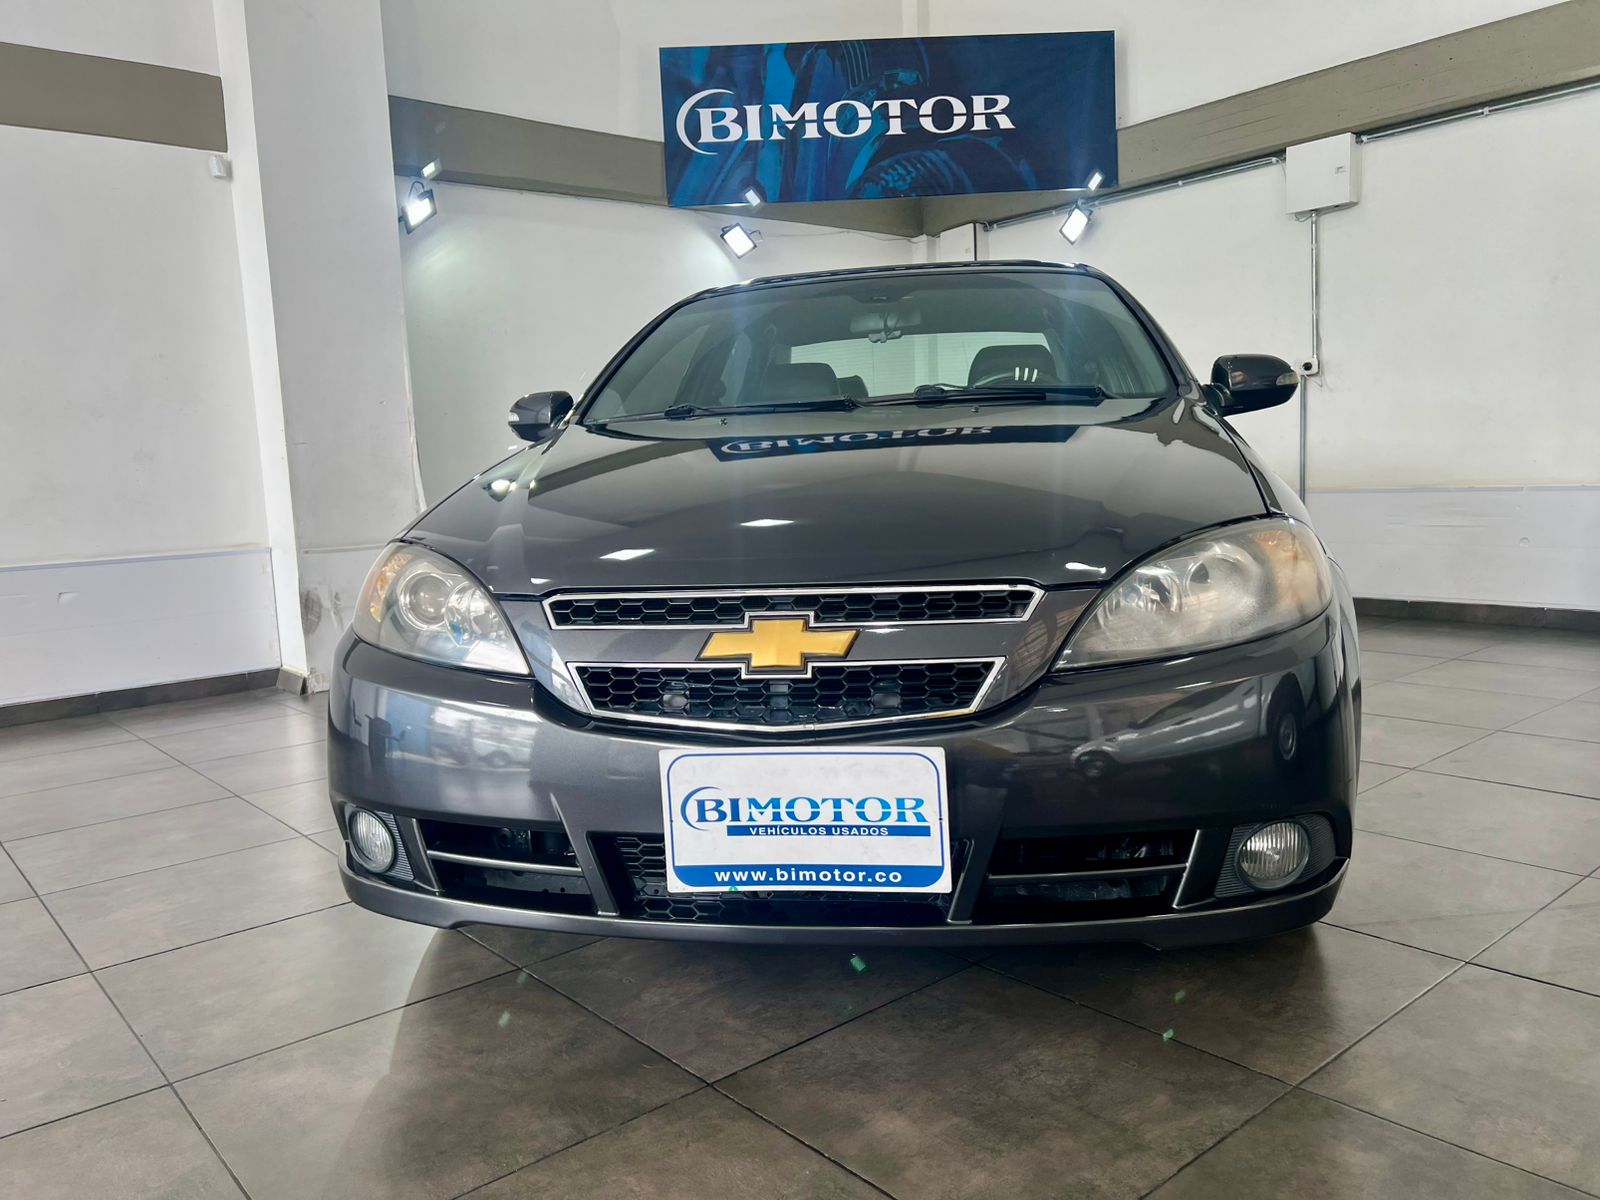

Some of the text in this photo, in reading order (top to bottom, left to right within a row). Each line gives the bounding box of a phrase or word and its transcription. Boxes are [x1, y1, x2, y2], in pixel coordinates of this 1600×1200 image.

[695, 95, 1016, 143] BIMOTOR
[695, 797, 928, 823] BIMOTOR
[749, 825, 889, 836] VEHÍCULOS USADOS
[714, 868, 902, 882] www.bimotor.co
